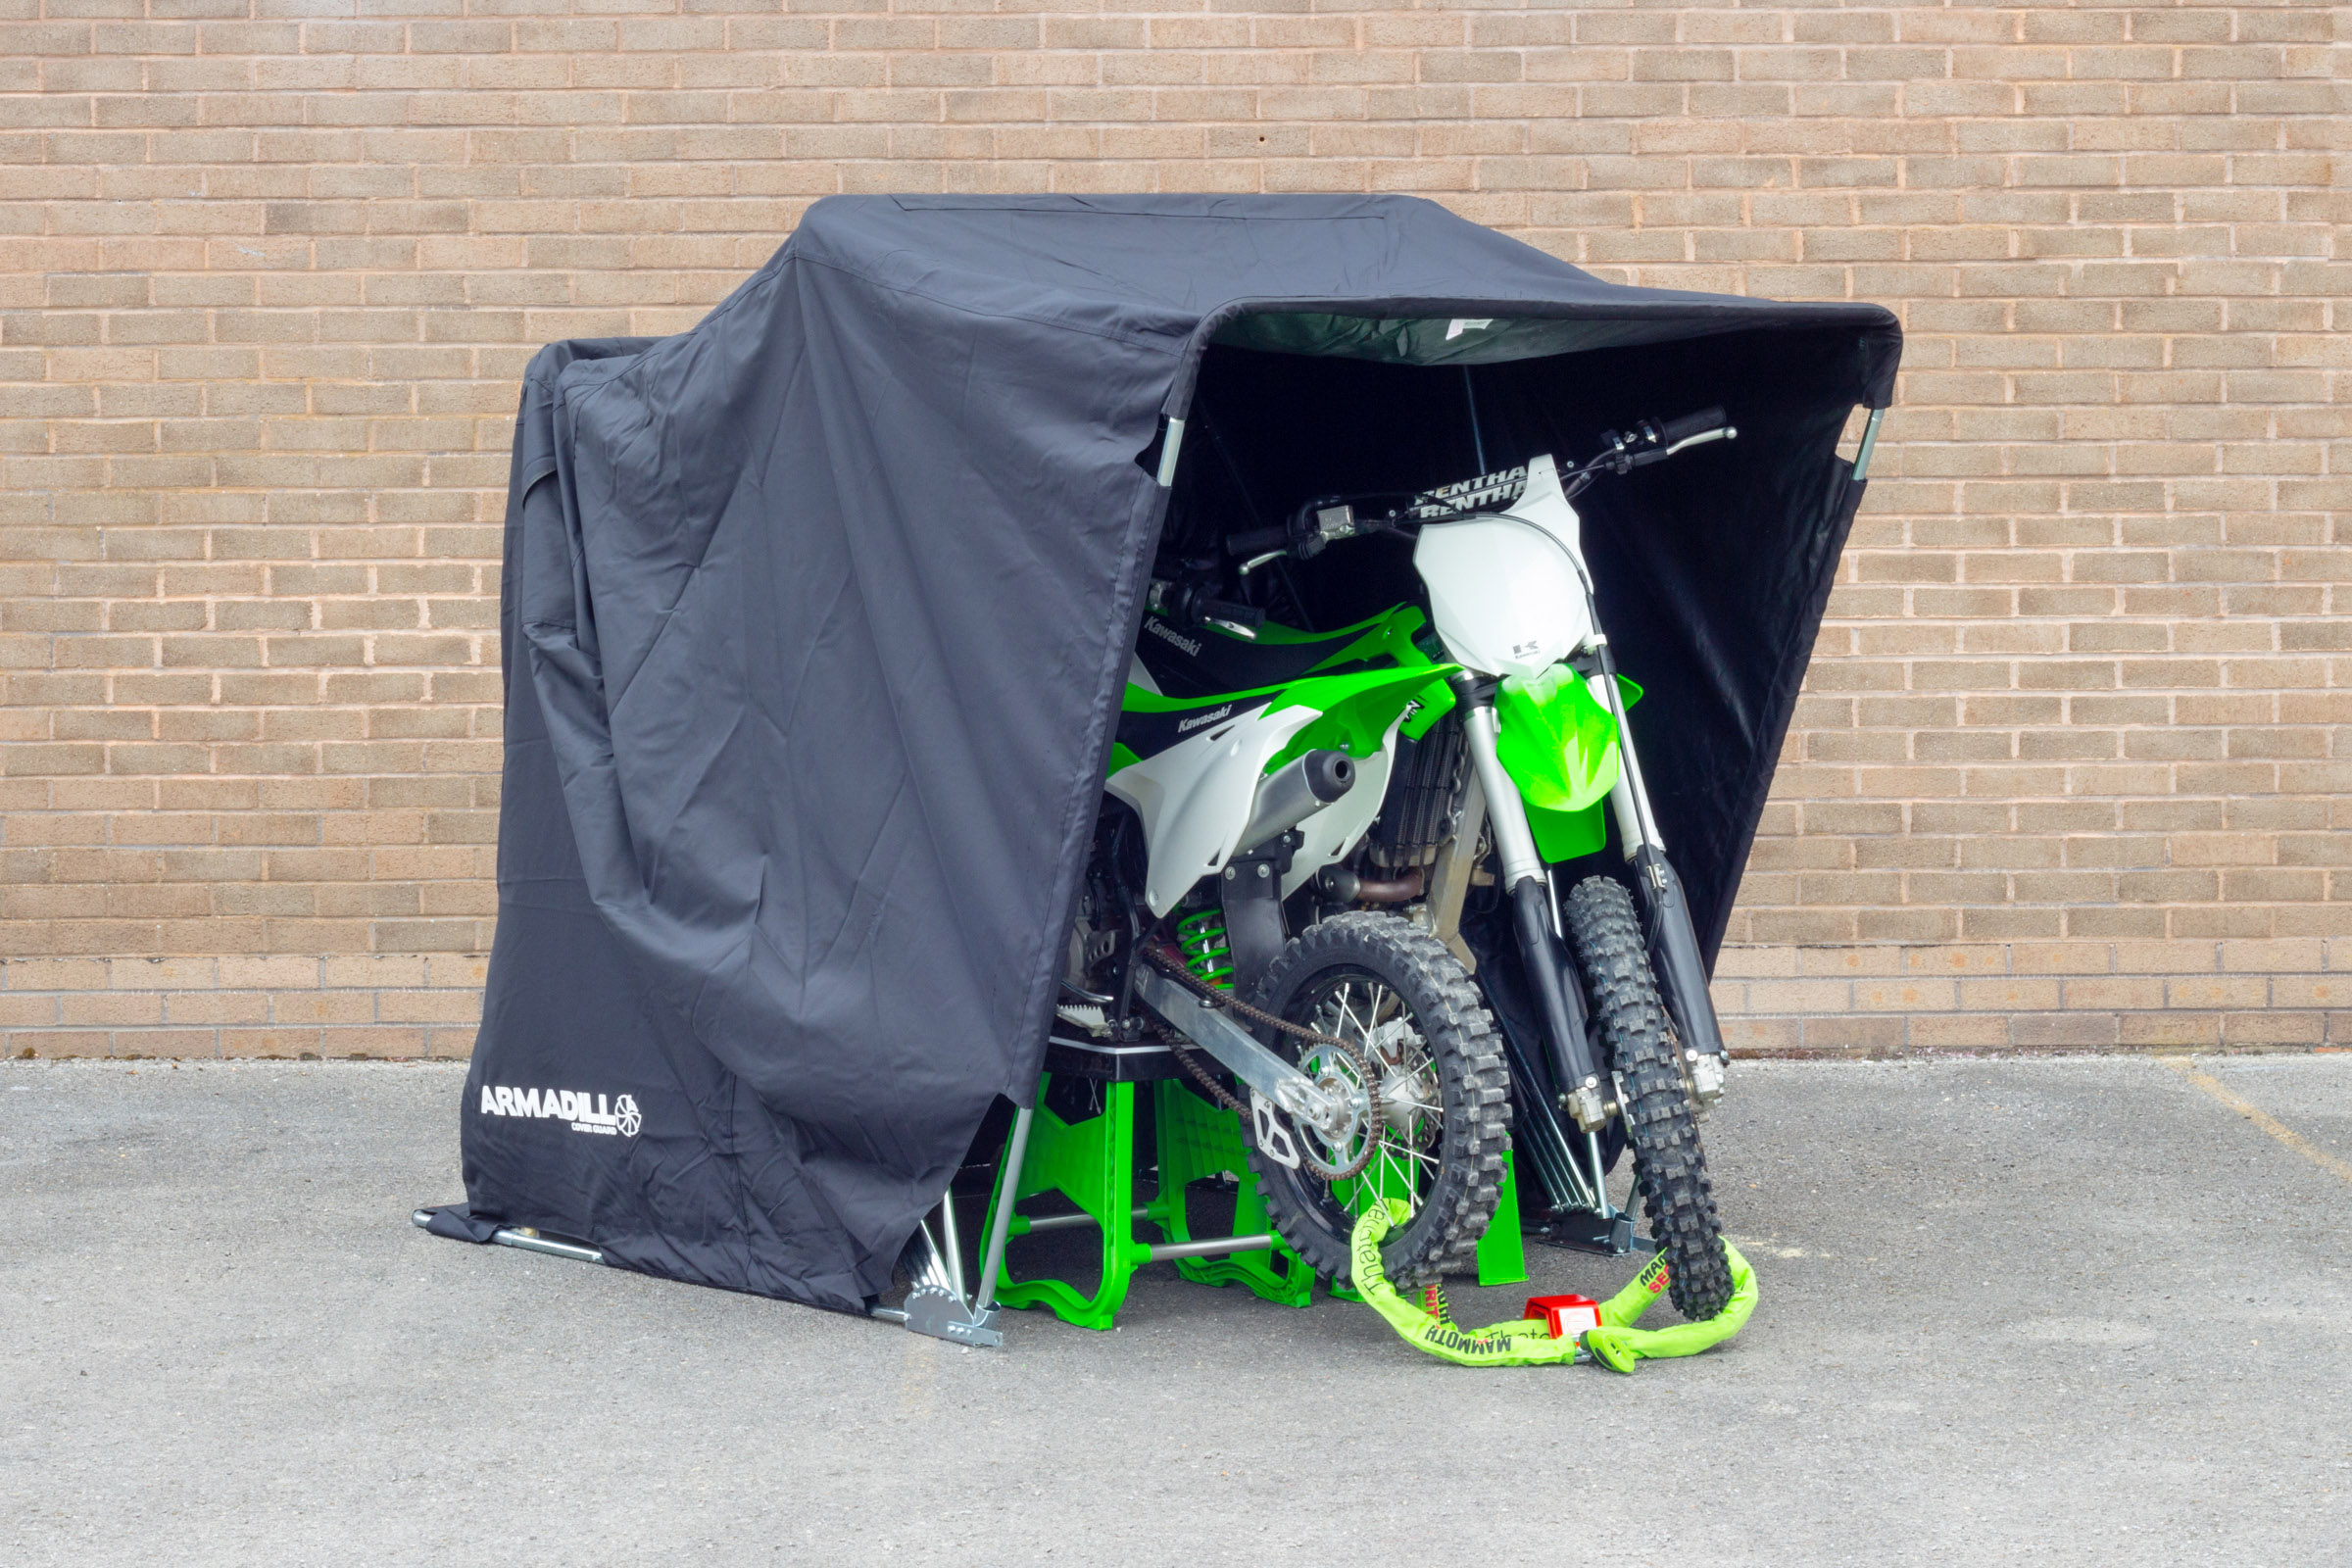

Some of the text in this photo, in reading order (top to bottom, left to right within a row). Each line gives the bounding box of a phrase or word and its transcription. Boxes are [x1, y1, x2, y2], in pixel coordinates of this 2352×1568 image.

[1144, 615, 1202, 658] Kawasaki
[1177, 704, 1233, 733] Kawasaki
[1425, 1325, 1511, 1354] MAMMOTH
